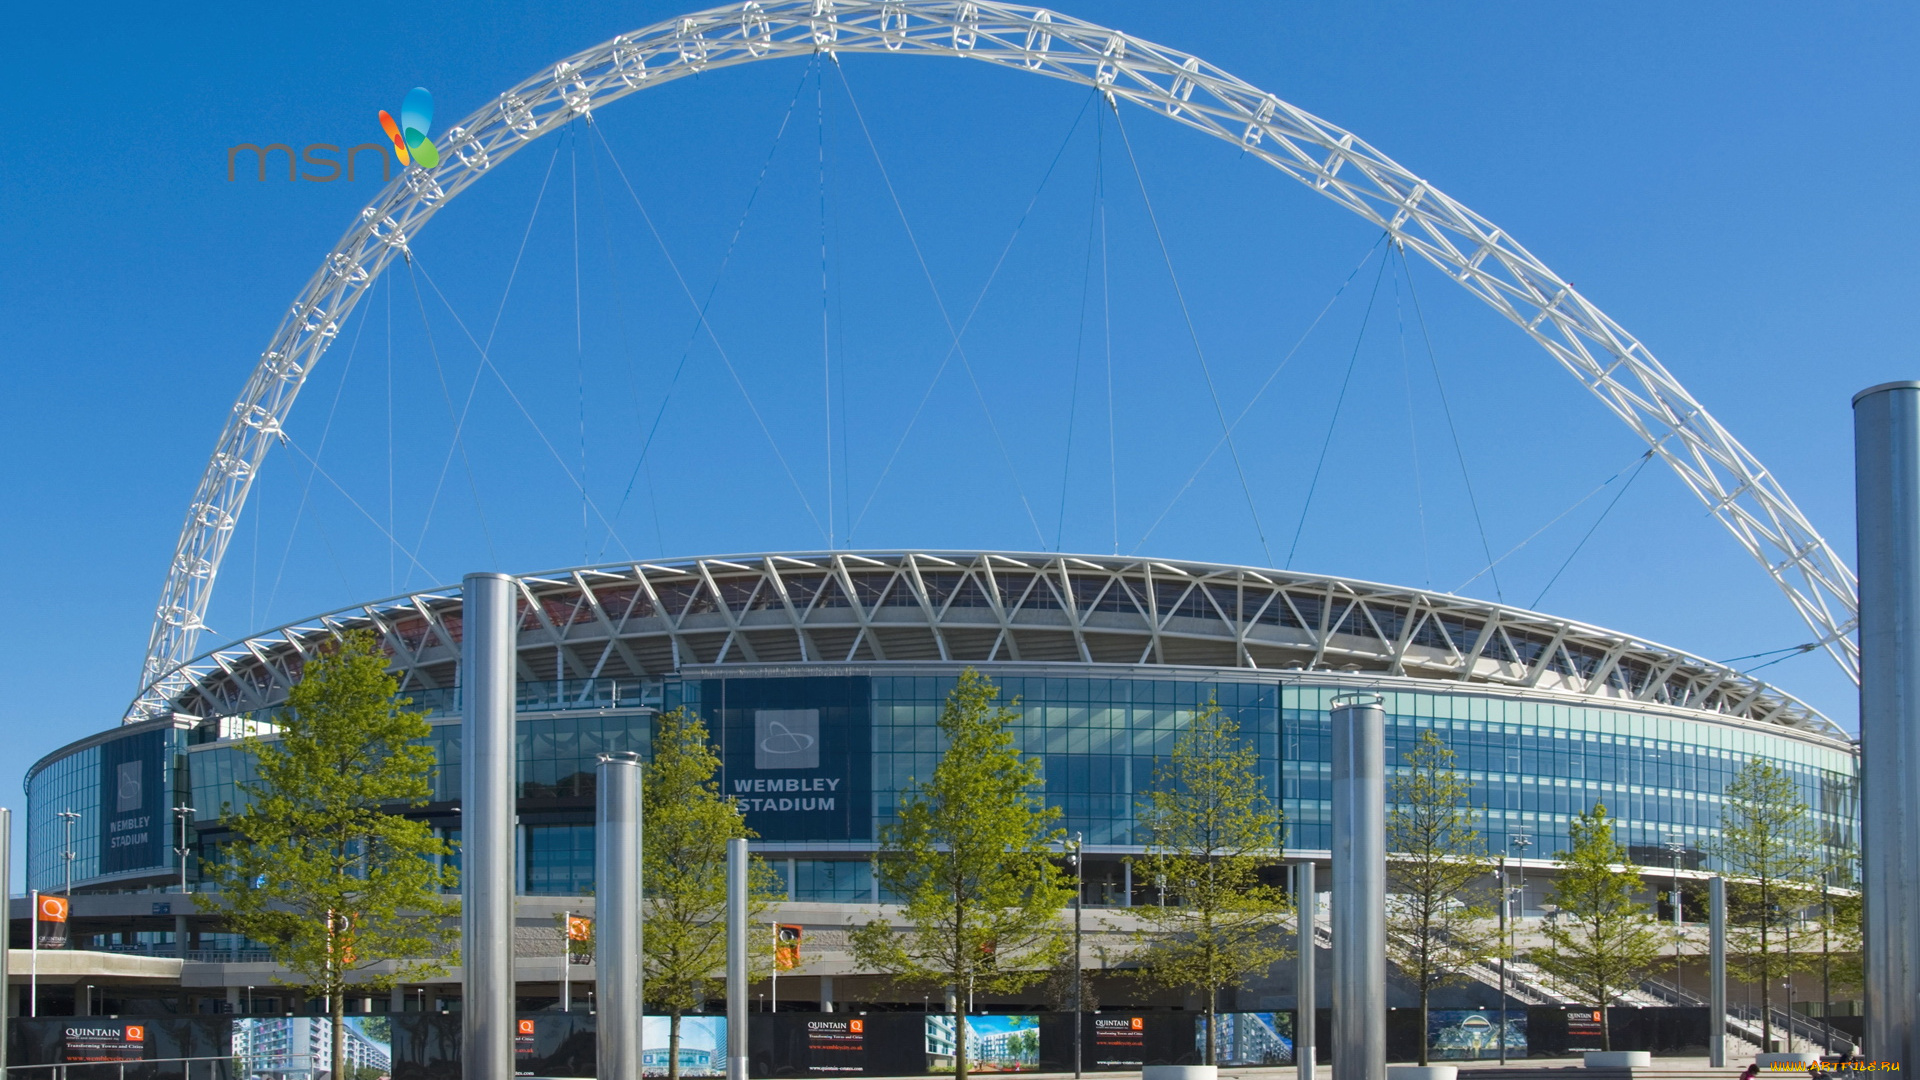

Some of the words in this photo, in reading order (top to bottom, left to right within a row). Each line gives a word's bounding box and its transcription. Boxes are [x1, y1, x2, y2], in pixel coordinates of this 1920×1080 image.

[734, 778, 840, 792] WEMBLEY
[738, 797, 834, 811] STADIUM
[110, 815, 150, 833] WEMBLEY
[111, 832, 148, 849] STADIUM
[42, 899, 65, 919] Q
[520, 1021, 534, 1032] Q
[807, 1021, 847, 1030] QUINTAIN
[851, 1020, 863, 1031] Q
[1095, 1019, 1129, 1027] QUINTAIN
[1132, 1018, 1143, 1028] Q
[65, 1027, 121, 1037] QUINTAIN
[127, 1027, 142, 1039] Q
